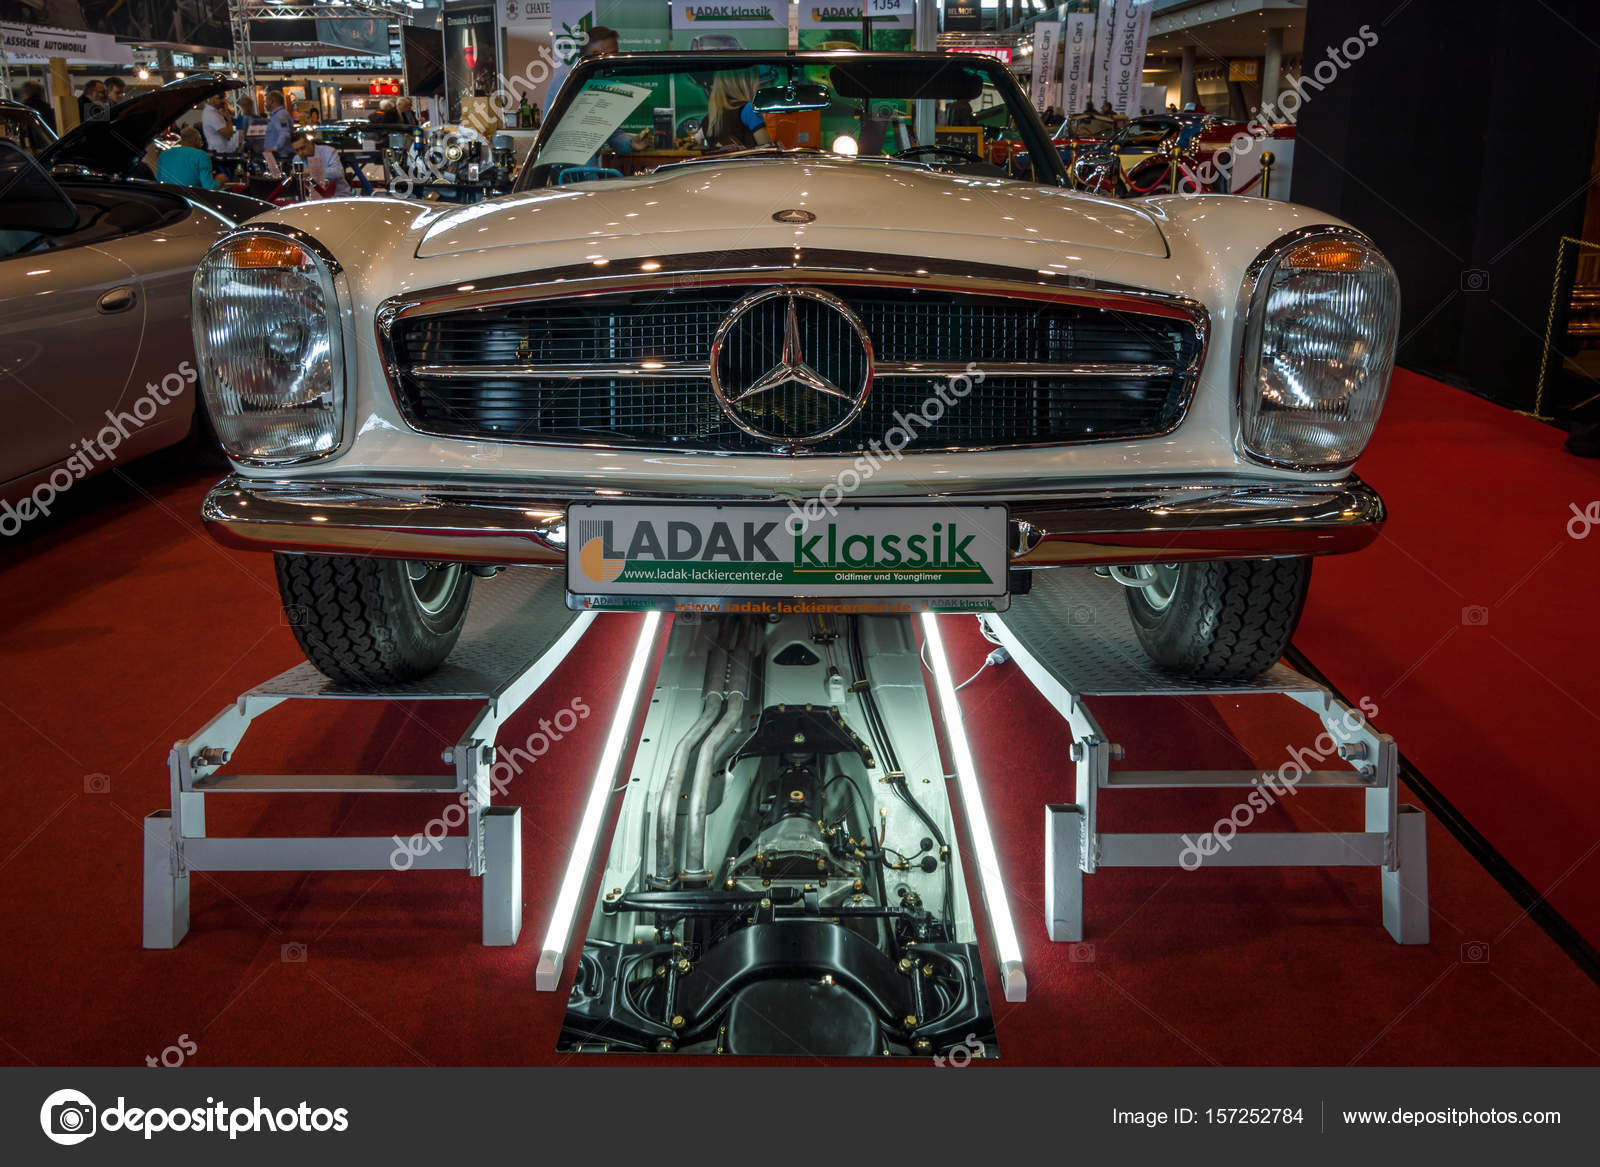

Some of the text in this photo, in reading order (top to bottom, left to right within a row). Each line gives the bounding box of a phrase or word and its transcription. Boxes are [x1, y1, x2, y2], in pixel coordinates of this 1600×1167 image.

[691, 5, 771, 17] LADAK klassik
[872, 0, 901, 10] 1J54
[817, 7, 855, 17] LADAK
[1073, 22, 1084, 44] Cars
[44, 41, 87, 53] AUTOMOBILE
[1120, 22, 1137, 66] Classic
[1069, 46, 1082, 80] Classic
[602, 520, 979, 568] LADAK klassik
[624, 567, 783, 582] www.ladak-lackiercenter.de
[835, 572, 942, 583] Oldtimer und Youngtimer
